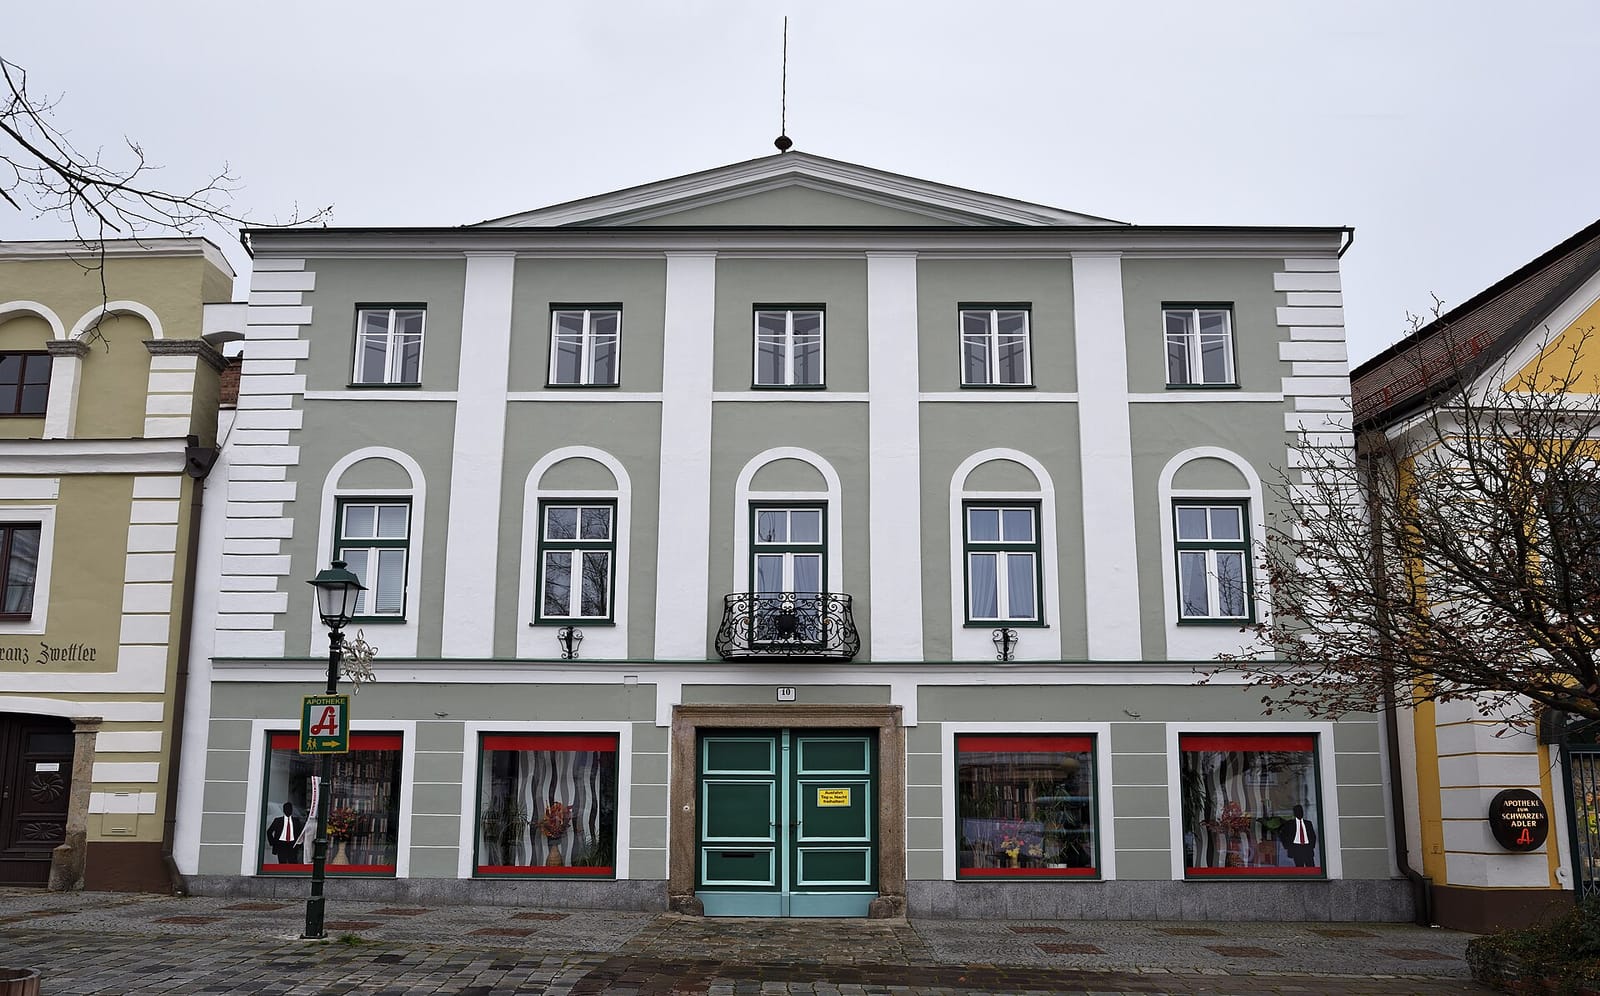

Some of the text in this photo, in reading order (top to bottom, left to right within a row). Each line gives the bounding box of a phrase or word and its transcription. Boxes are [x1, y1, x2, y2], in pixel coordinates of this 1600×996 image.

[0, 642, 96, 665] ranz Zwettler
[782, 687, 791, 696] 10
[1501, 812, 1545, 820] SCHWARZEN
